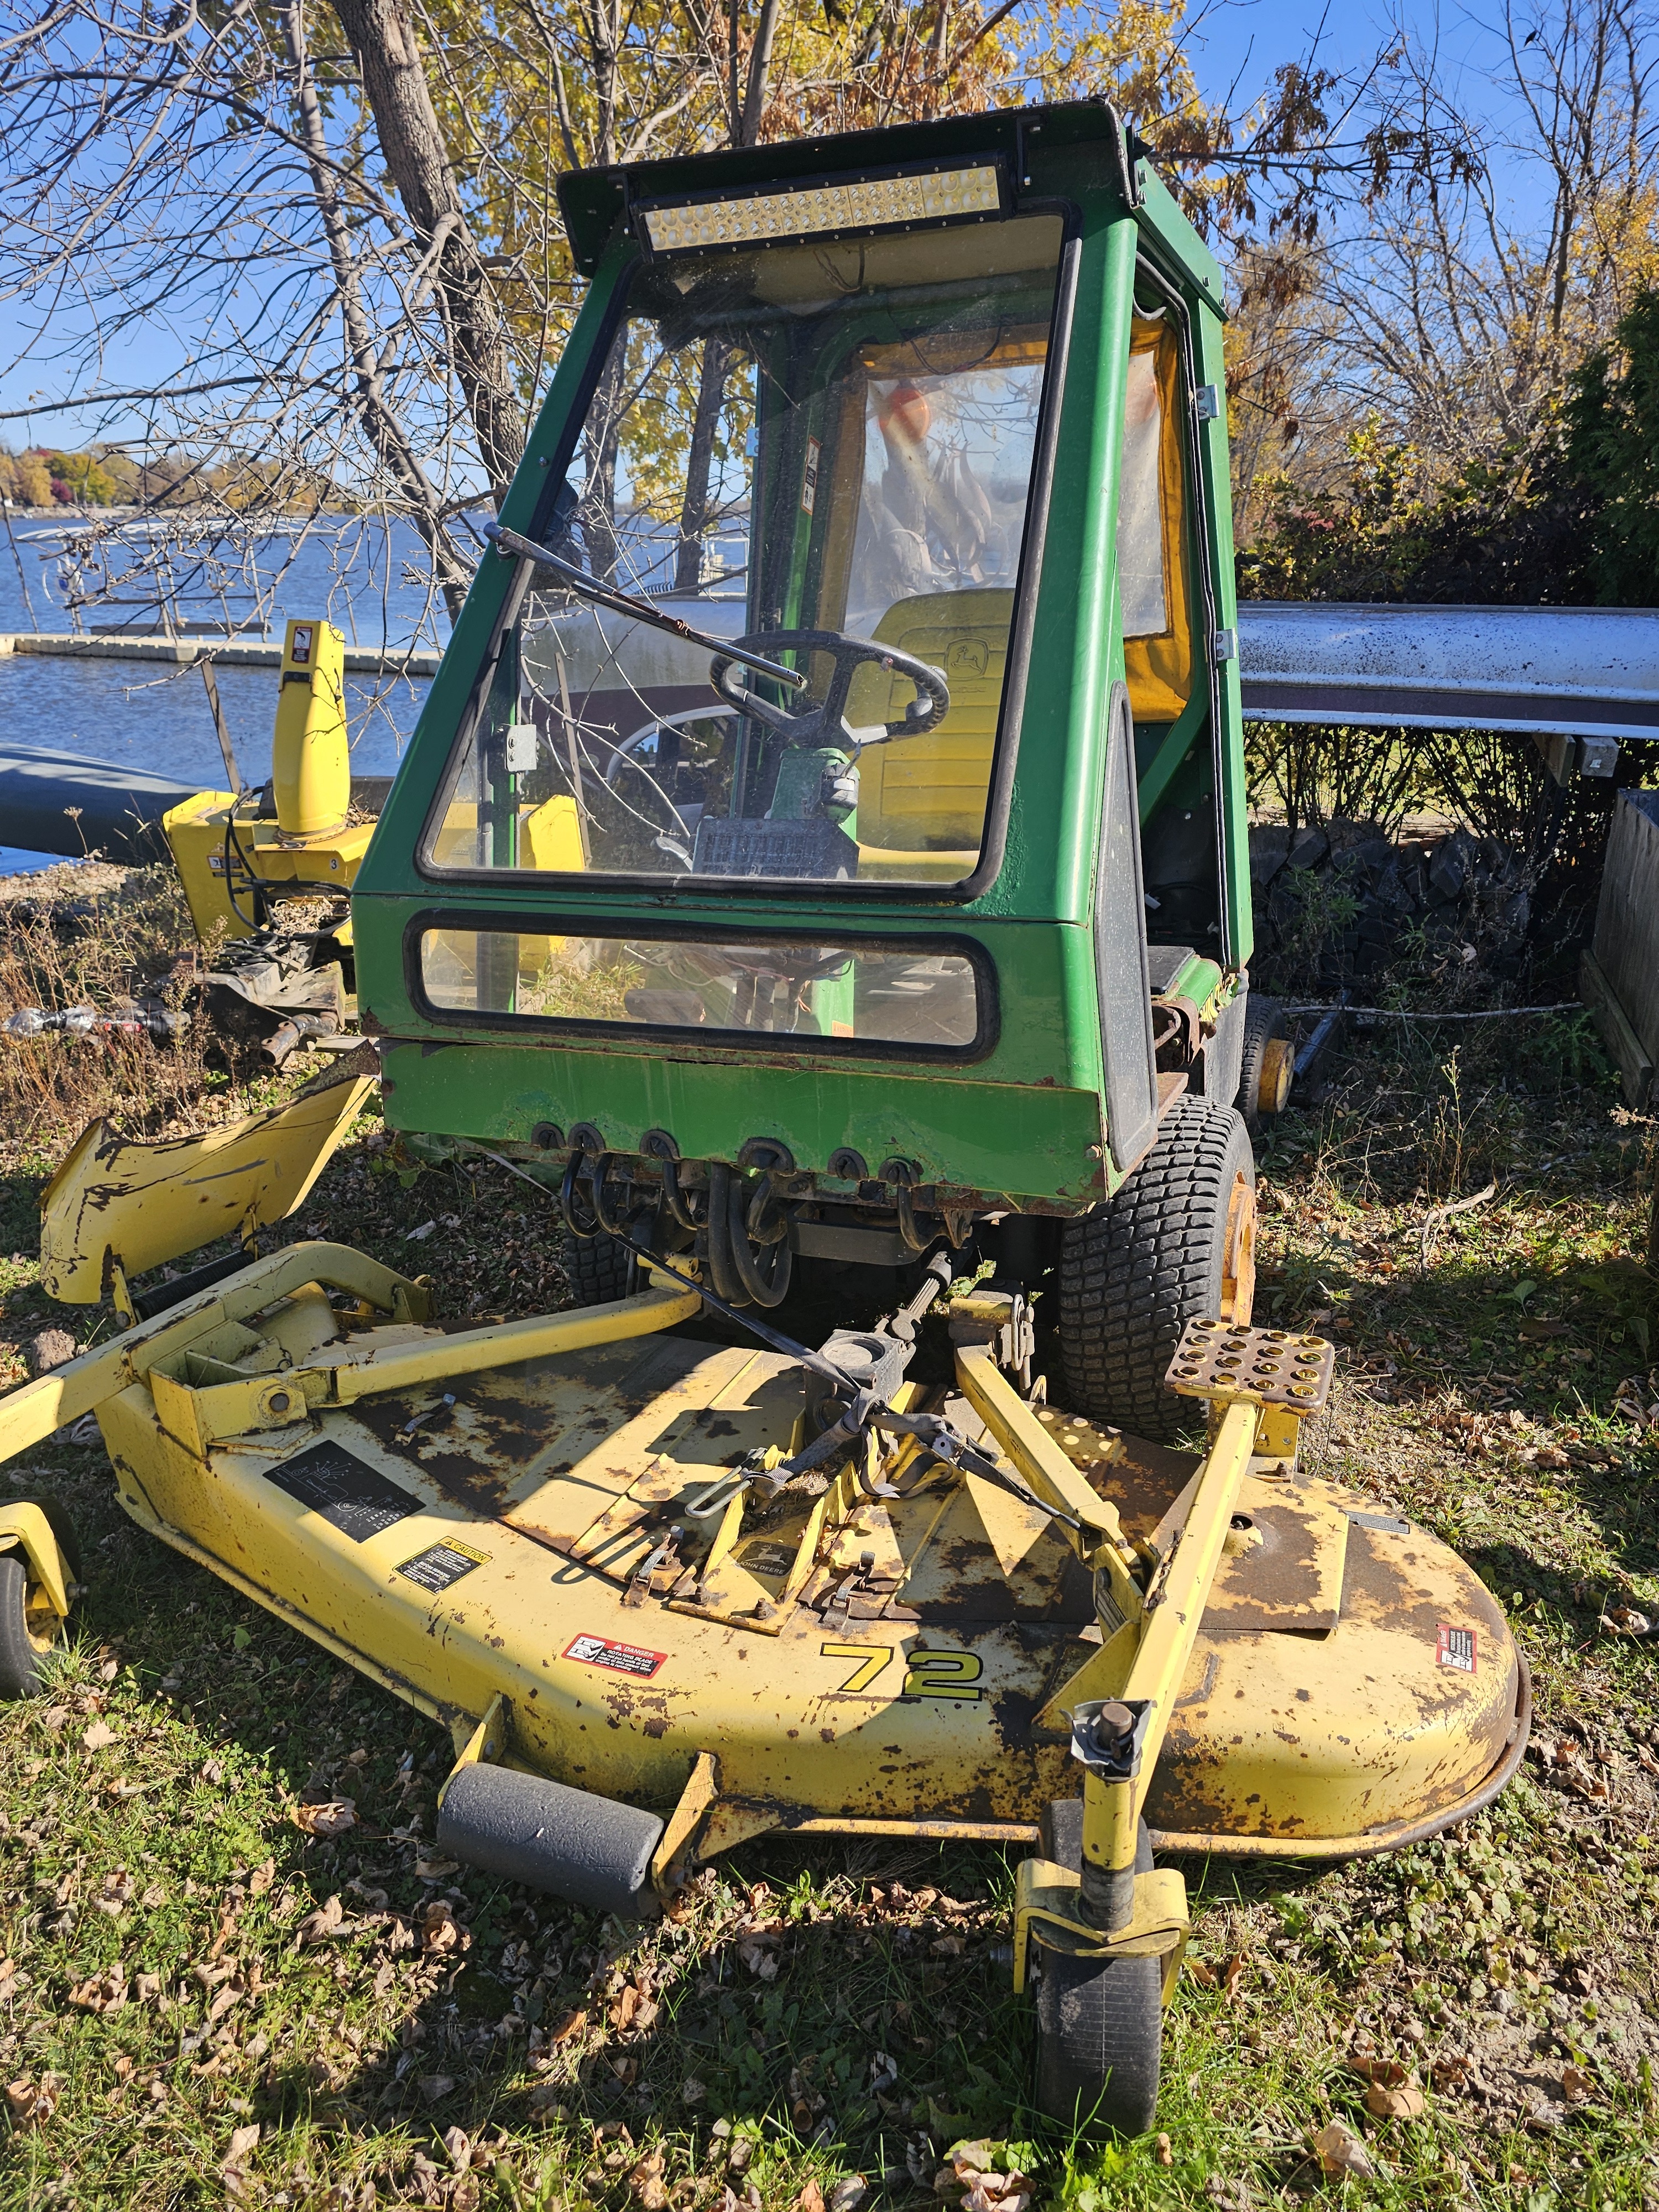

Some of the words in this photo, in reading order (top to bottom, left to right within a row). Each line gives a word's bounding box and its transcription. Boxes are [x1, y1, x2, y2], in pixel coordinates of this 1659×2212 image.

[331, 859, 337, 869] 3
[453, 1543, 487, 1561] CAUTION
[759, 1565, 786, 1574] DEERE
[607, 1650, 634, 1659] ROTATING
[634, 1656, 654, 1664] BLADE
[624, 1646, 654, 1657] DANGER
[820, 1642, 983, 1701] 72
